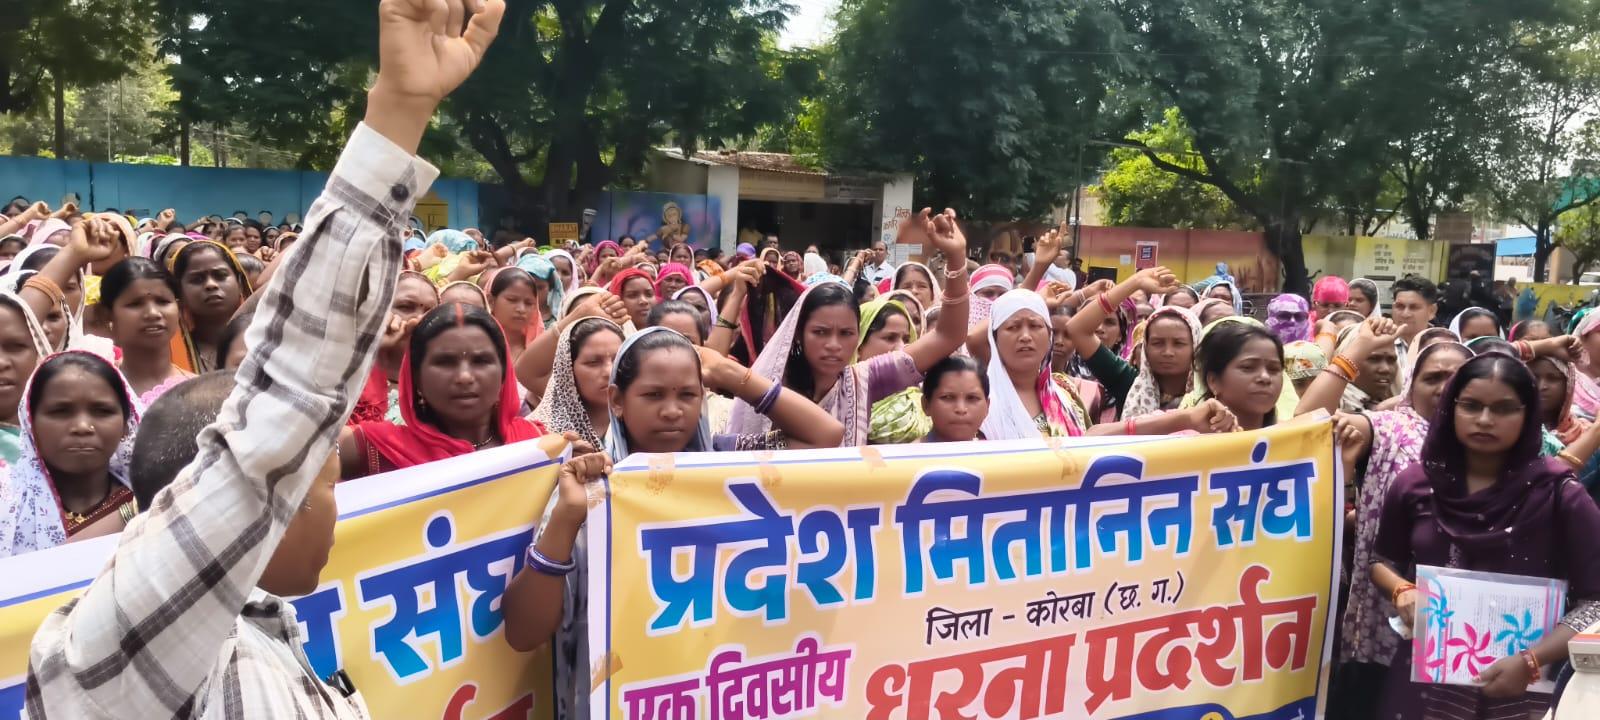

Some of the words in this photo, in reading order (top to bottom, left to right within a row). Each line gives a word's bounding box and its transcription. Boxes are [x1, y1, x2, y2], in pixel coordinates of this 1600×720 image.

[641, 483, 880, 630] प्रदेश
[897, 455, 1198, 593] मितानिन
[1210, 442, 1315, 546] संघ
[624, 677, 701, 720] एक
[705, 637, 852, 720] दिवसीय
[865, 633, 1076, 720] धरना
[1083, 565, 1318, 716] प्रदर्शन
[926, 606, 993, 645] जिला
[1026, 590, 1097, 628] कोरबा
